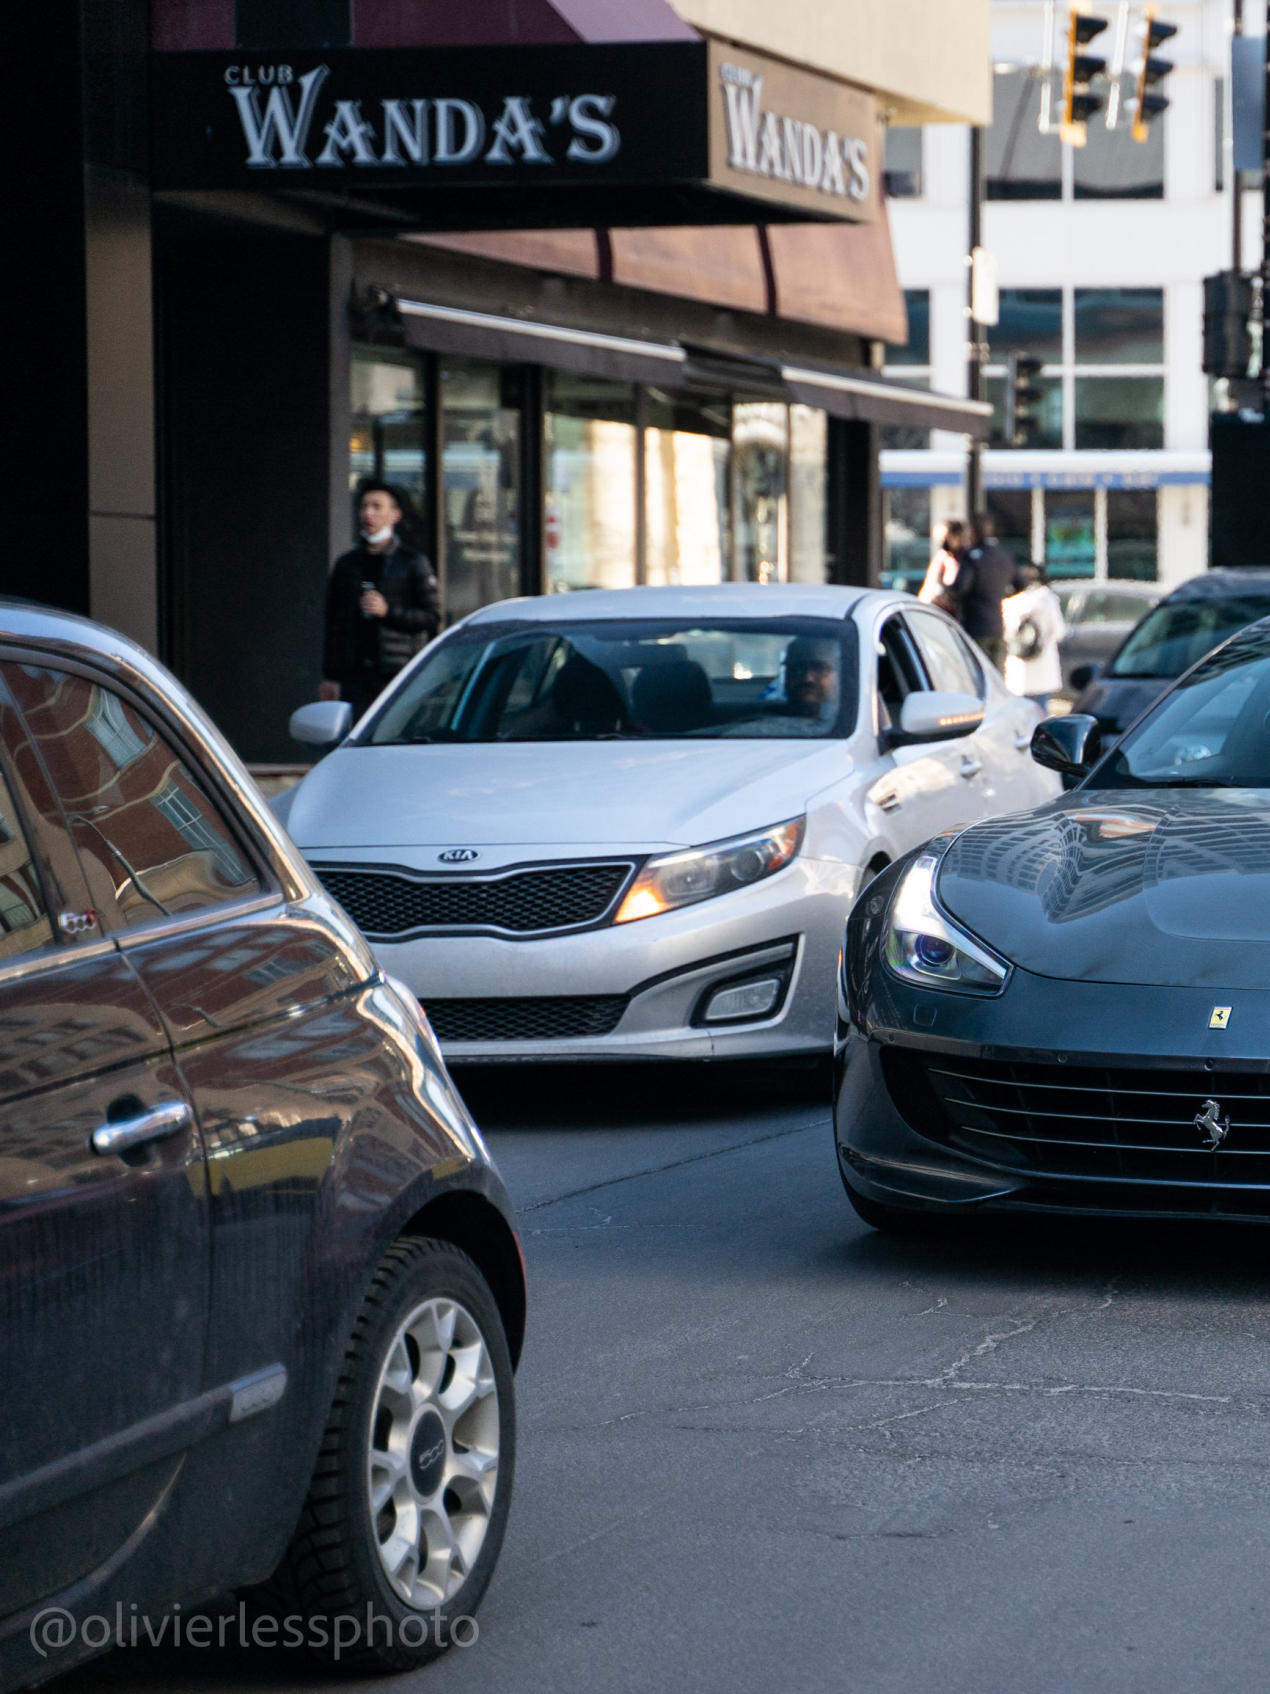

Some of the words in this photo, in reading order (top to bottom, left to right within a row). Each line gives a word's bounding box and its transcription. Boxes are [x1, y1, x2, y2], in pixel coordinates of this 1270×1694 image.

[224, 64, 292, 85] CLUB
[228, 62, 622, 169] WANDA'S
[723, 73, 870, 203] WANDA'S
[441, 849, 476, 861] KIA
[419, 1439, 445, 1469] 500
